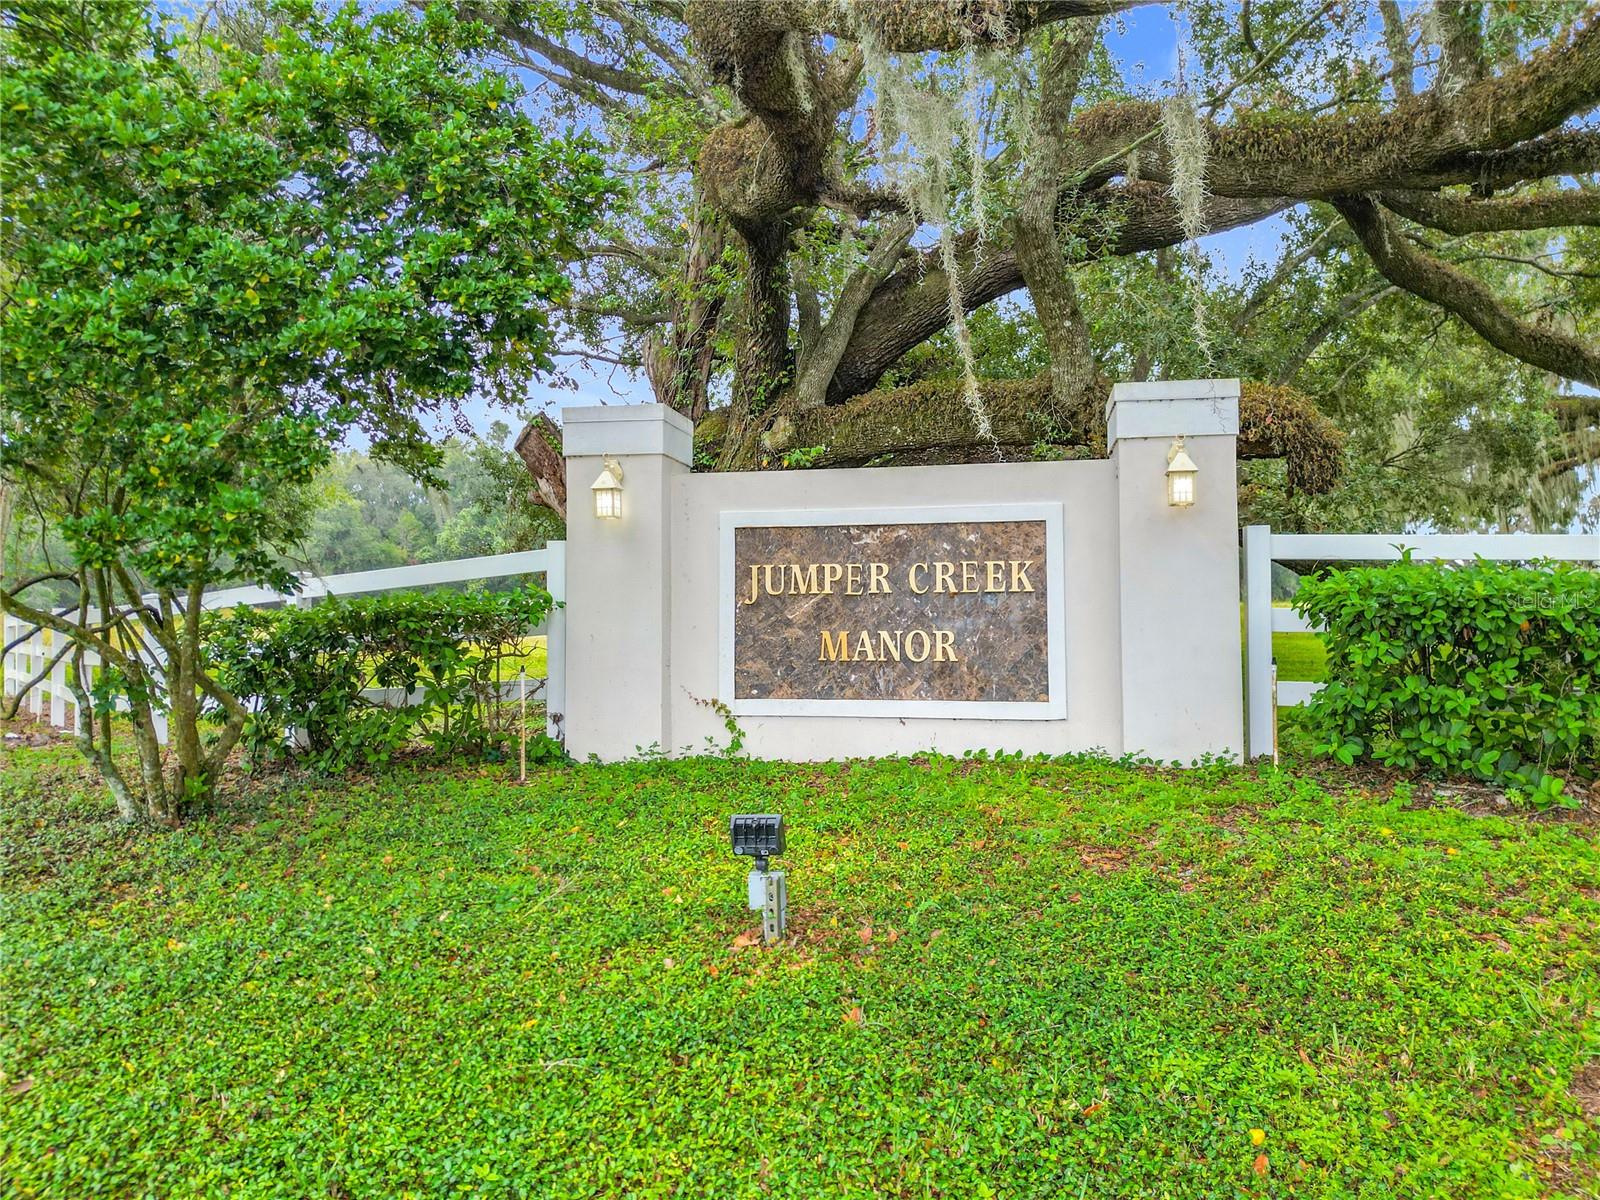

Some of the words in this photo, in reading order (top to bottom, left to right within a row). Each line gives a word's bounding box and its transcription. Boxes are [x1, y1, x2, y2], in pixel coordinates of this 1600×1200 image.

[744, 562, 893, 605] JUMPER
[908, 560, 1036, 595] CREEK
[818, 629, 959, 662] MANOR
